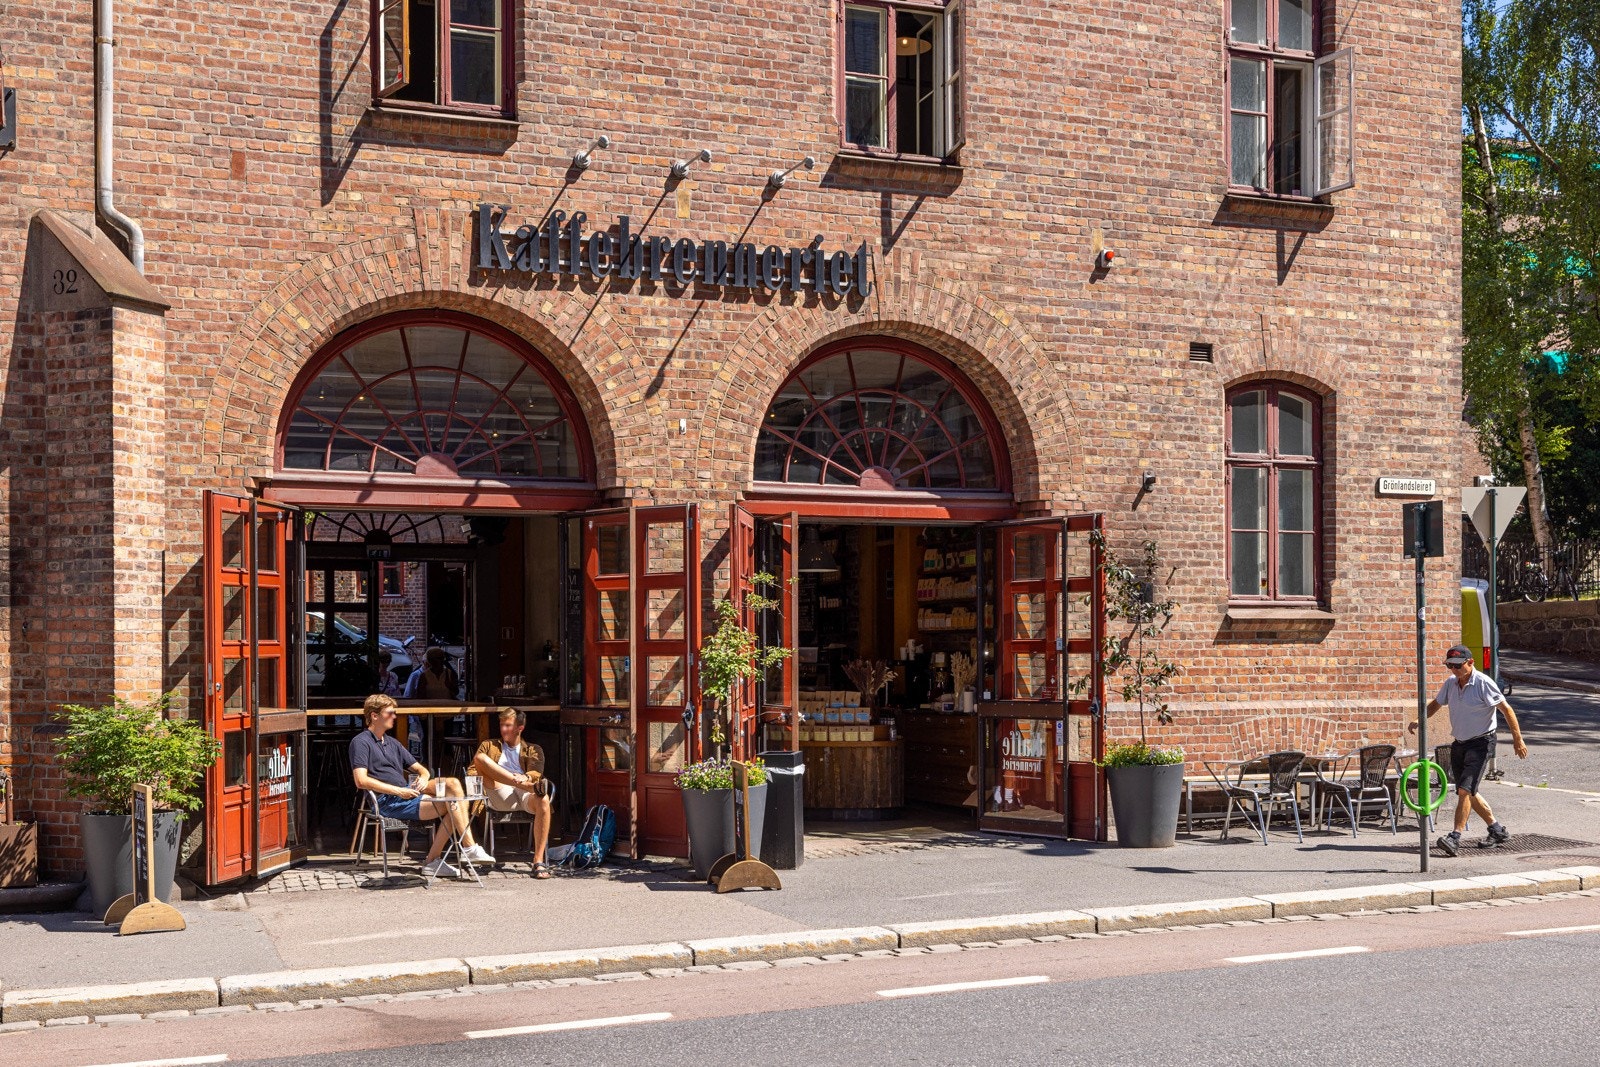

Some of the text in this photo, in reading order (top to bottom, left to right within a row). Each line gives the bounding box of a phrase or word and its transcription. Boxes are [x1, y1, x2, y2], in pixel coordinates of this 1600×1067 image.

[477, 203, 873, 298] Kaffebrenneriet
[53, 269, 78, 295] 32
[1383, 480, 1432, 491] Grönlandsleiret
